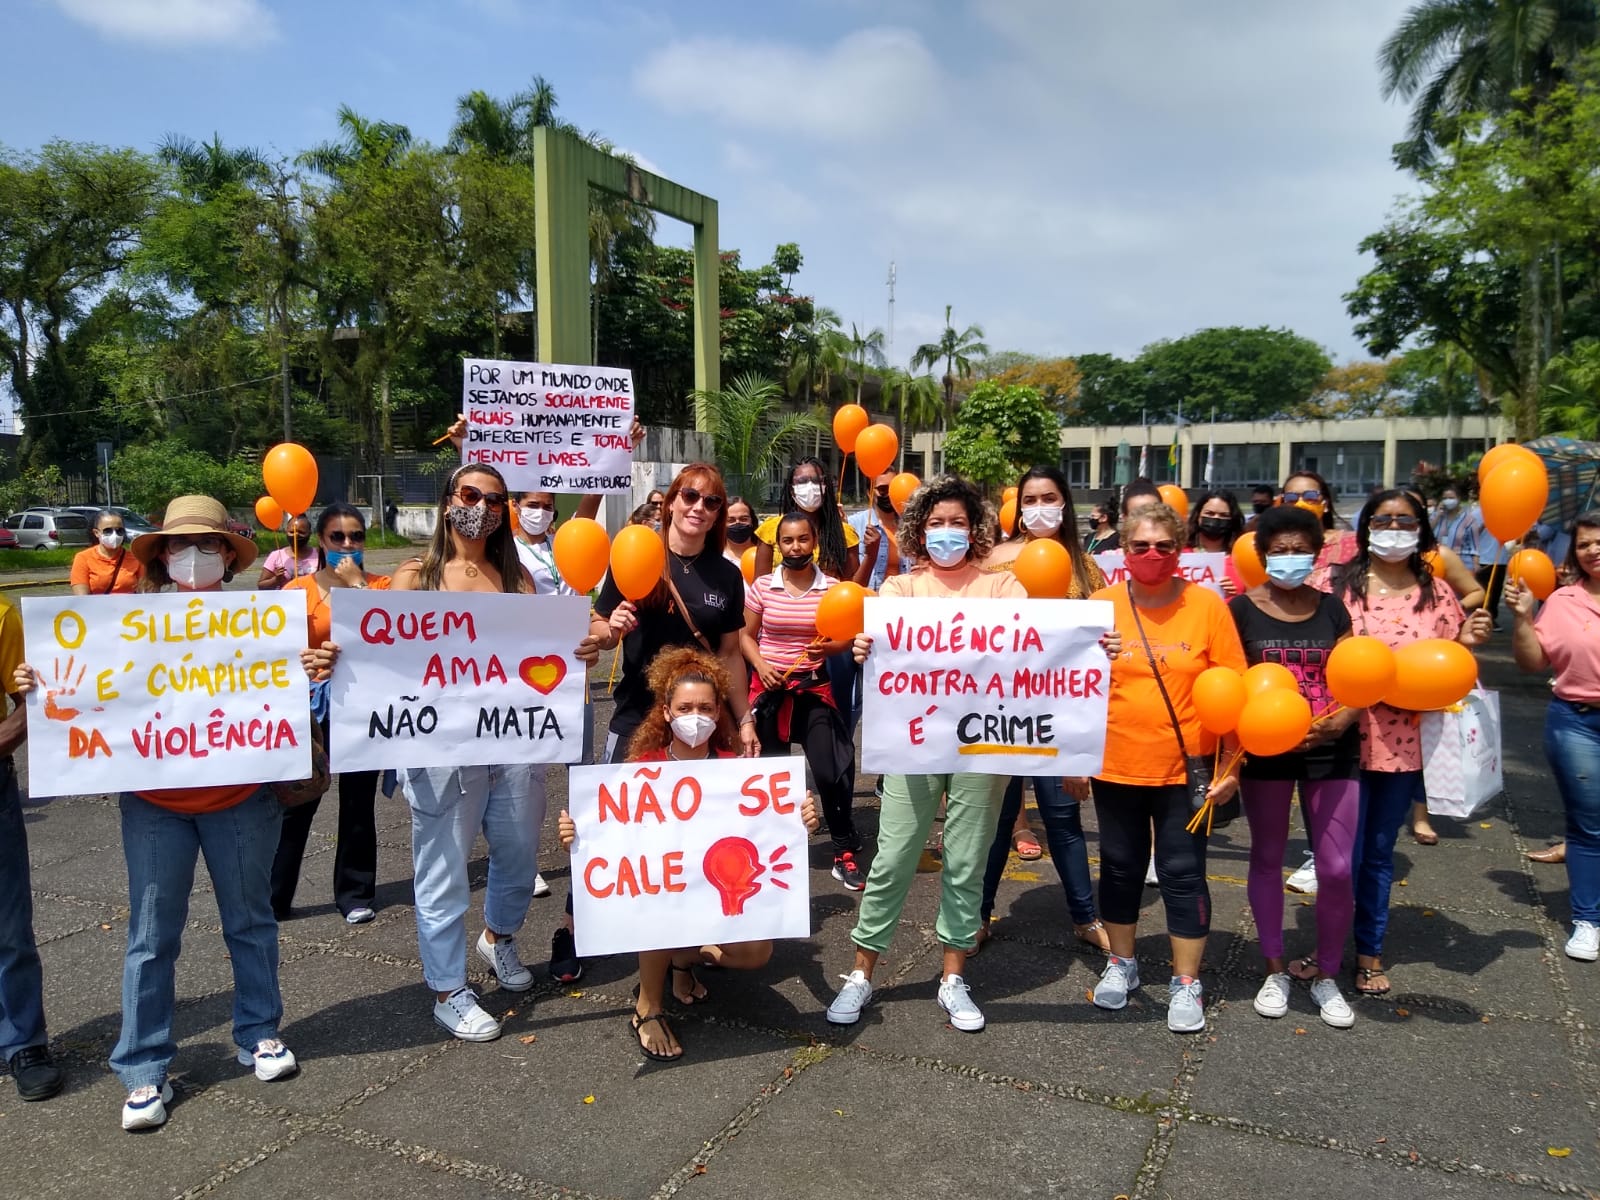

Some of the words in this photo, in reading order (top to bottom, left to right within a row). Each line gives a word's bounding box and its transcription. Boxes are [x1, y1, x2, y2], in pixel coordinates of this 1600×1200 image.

[470, 365, 500, 385] POR
[512, 370, 534, 386] UM
[542, 372, 591, 389] MUNDO
[595, 377, 630, 392] ONDE
[468, 390, 538, 406] SEJAMOS
[544, 391, 630, 410] SOCIALMENTE
[470, 407, 514, 425] IGUAIS
[522, 414, 622, 428] HUMANAMENTE
[470, 430, 562, 444] DIFERENTES
[571, 433, 584, 446] E
[468, 450, 528, 466] MENTE
[538, 450, 590, 468] LIVRES.
[540, 476, 564, 488] ROSA
[570, 476, 632, 489] LUXEMBURGO
[54, 610, 86, 649] O
[120, 594, 286, 643] SILÊNCIO
[360, 608, 477, 645] QUEM
[97, 661, 134, 701] É
[422, 653, 508, 688] AMA
[879, 669, 978, 696] CONTRA
[986, 674, 1004, 698] A
[68, 726, 112, 758] DA
[132, 704, 298, 760] VIOLÊNCIA
[368, 696, 438, 738] NÃO
[476, 706, 564, 740] MATA
[910, 704, 938, 745] É
[956, 704, 1055, 744] CRIME
[598, 767, 702, 825] NÃO
[738, 772, 795, 816] SE
[584, 851, 687, 898] CALE
